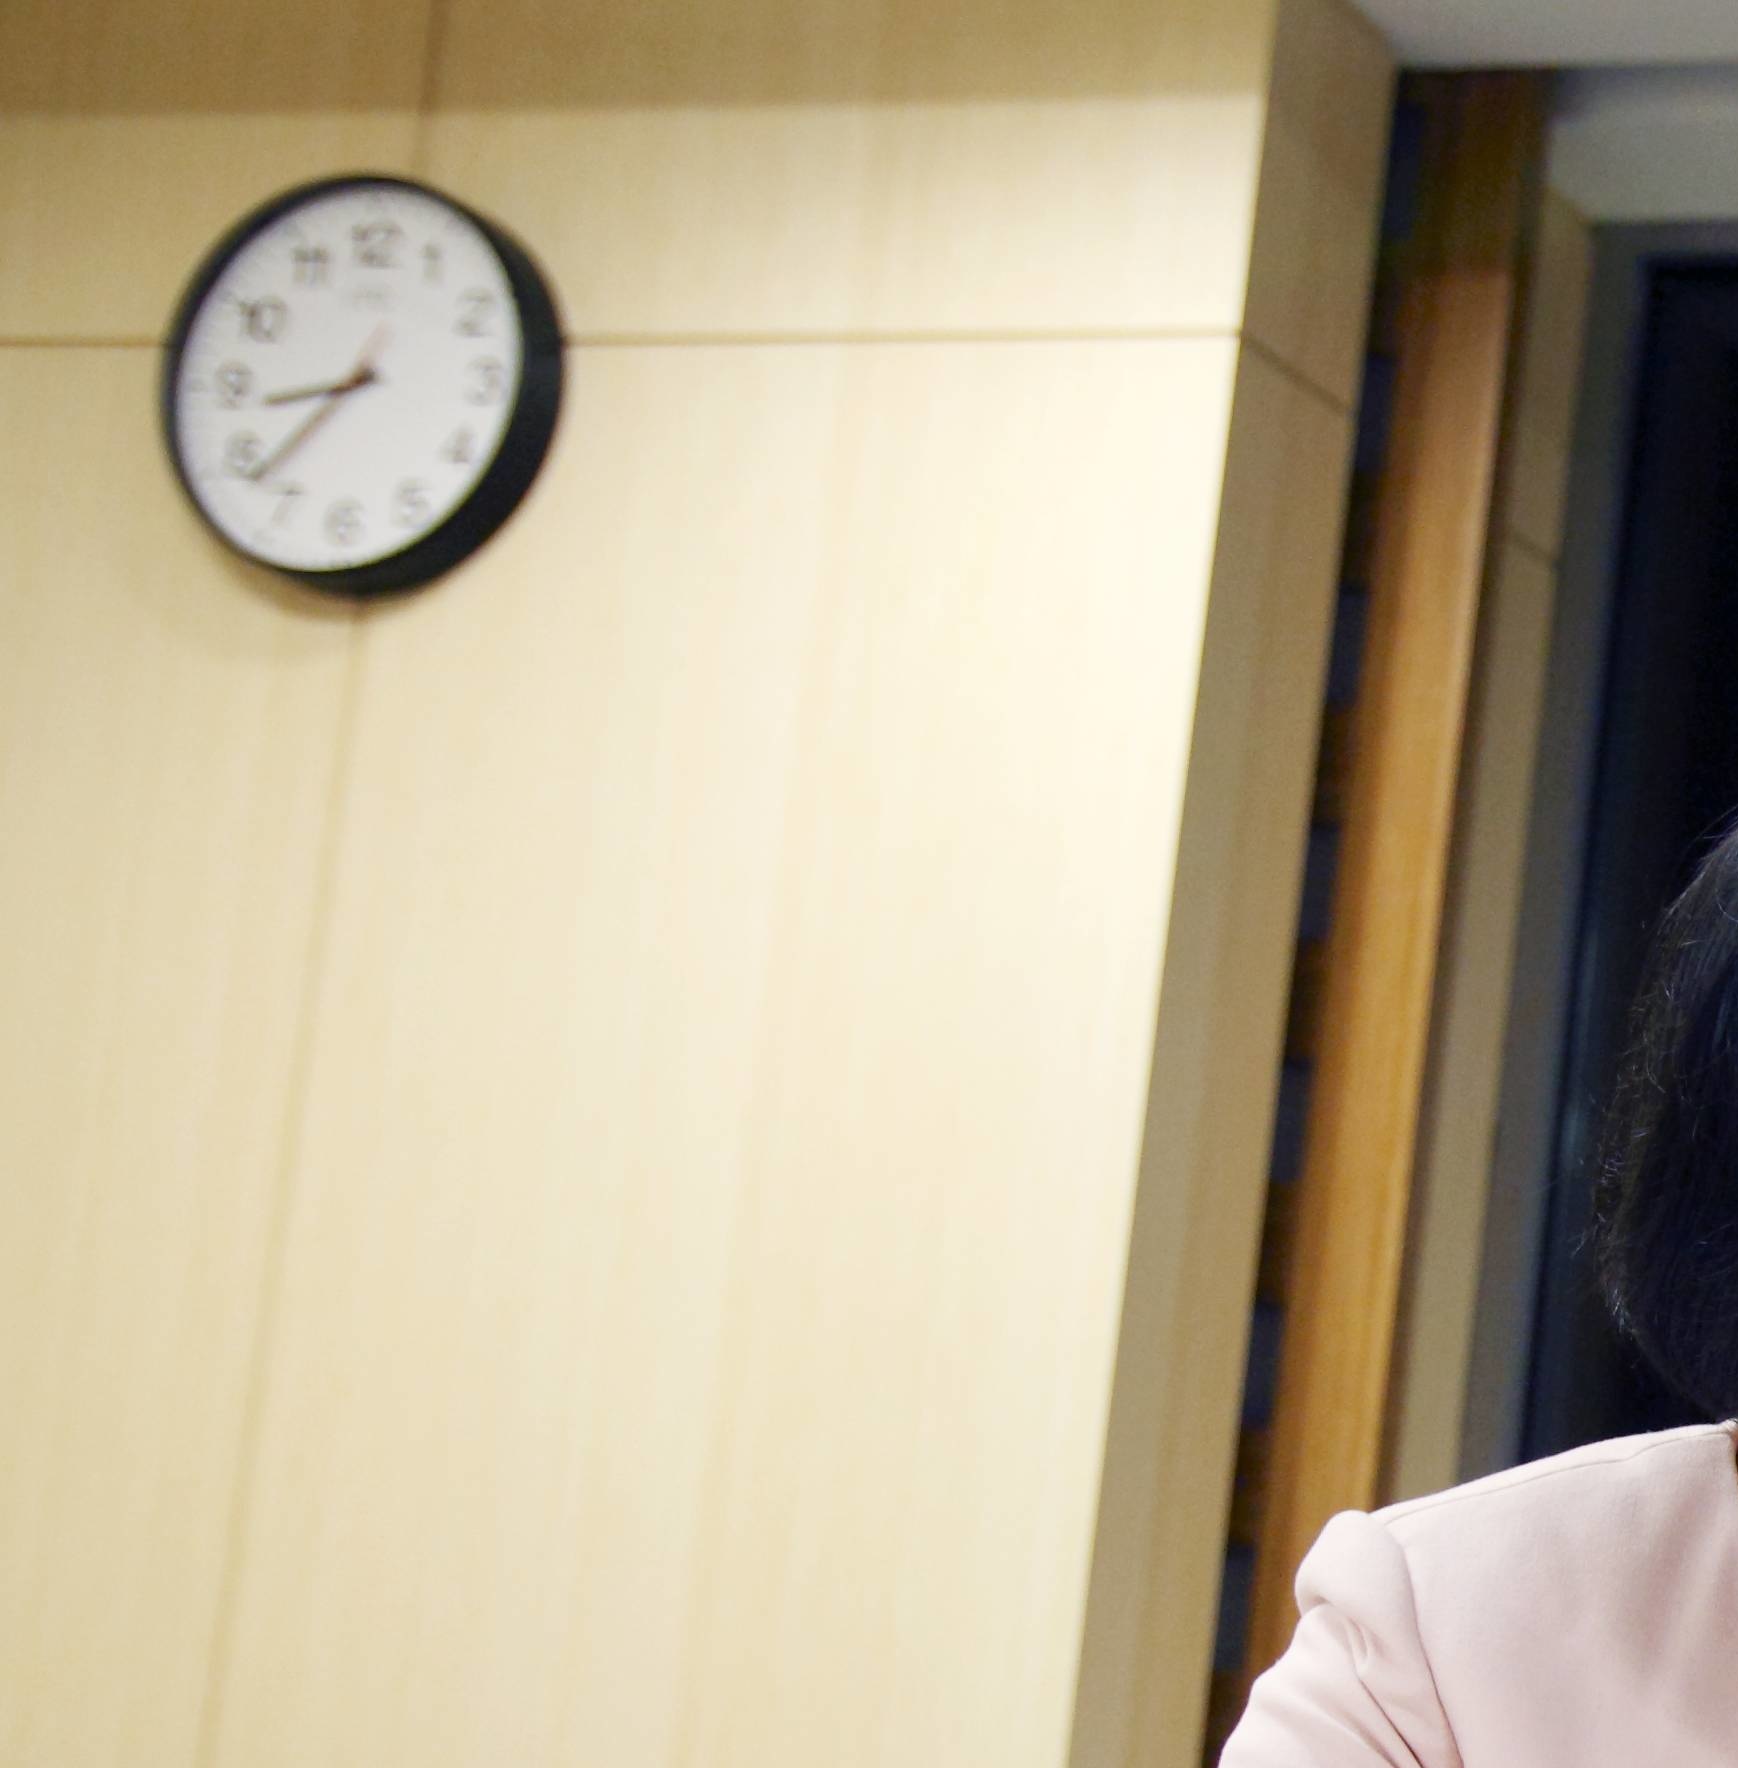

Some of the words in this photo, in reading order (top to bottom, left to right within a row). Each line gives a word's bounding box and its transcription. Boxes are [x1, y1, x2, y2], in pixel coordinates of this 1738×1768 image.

[292, 244, 329, 287] 11
[350, 221, 402, 269] 12
[422, 240, 443, 285] 1
[240, 296, 288, 344] 10
[455, 291, 495, 338] 2
[214, 361, 253, 409] 9
[464, 356, 501, 405] 3
[222, 430, 264, 478] 8
[440, 424, 477, 464] 4
[268, 481, 303, 528] 7
[324, 498, 365, 547] 6
[391, 478, 434, 526] 5
